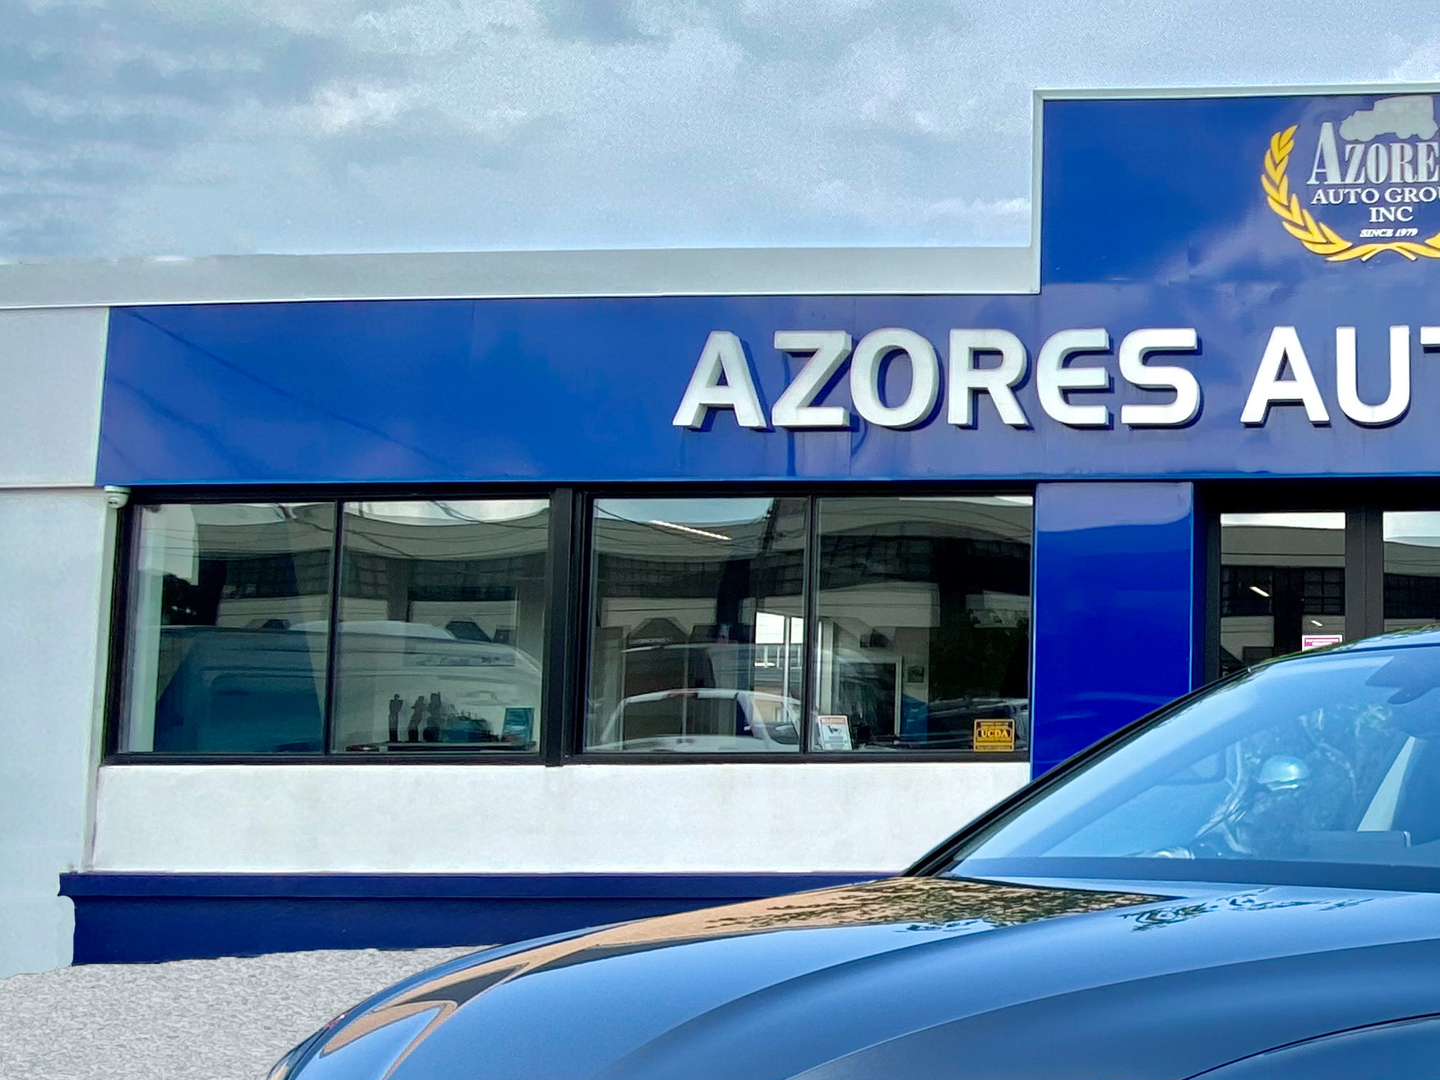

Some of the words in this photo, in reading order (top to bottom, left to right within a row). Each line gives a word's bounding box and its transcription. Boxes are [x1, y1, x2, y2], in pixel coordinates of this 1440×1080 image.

[1311, 188, 1380, 205] AUTO
[1369, 206, 1413, 223] INC
[1359, 228, 1394, 238] SINCE
[1394, 227, 1418, 237] 1979
[672, 327, 1203, 430] AZORES
[981, 729, 1009, 738] UCDA
